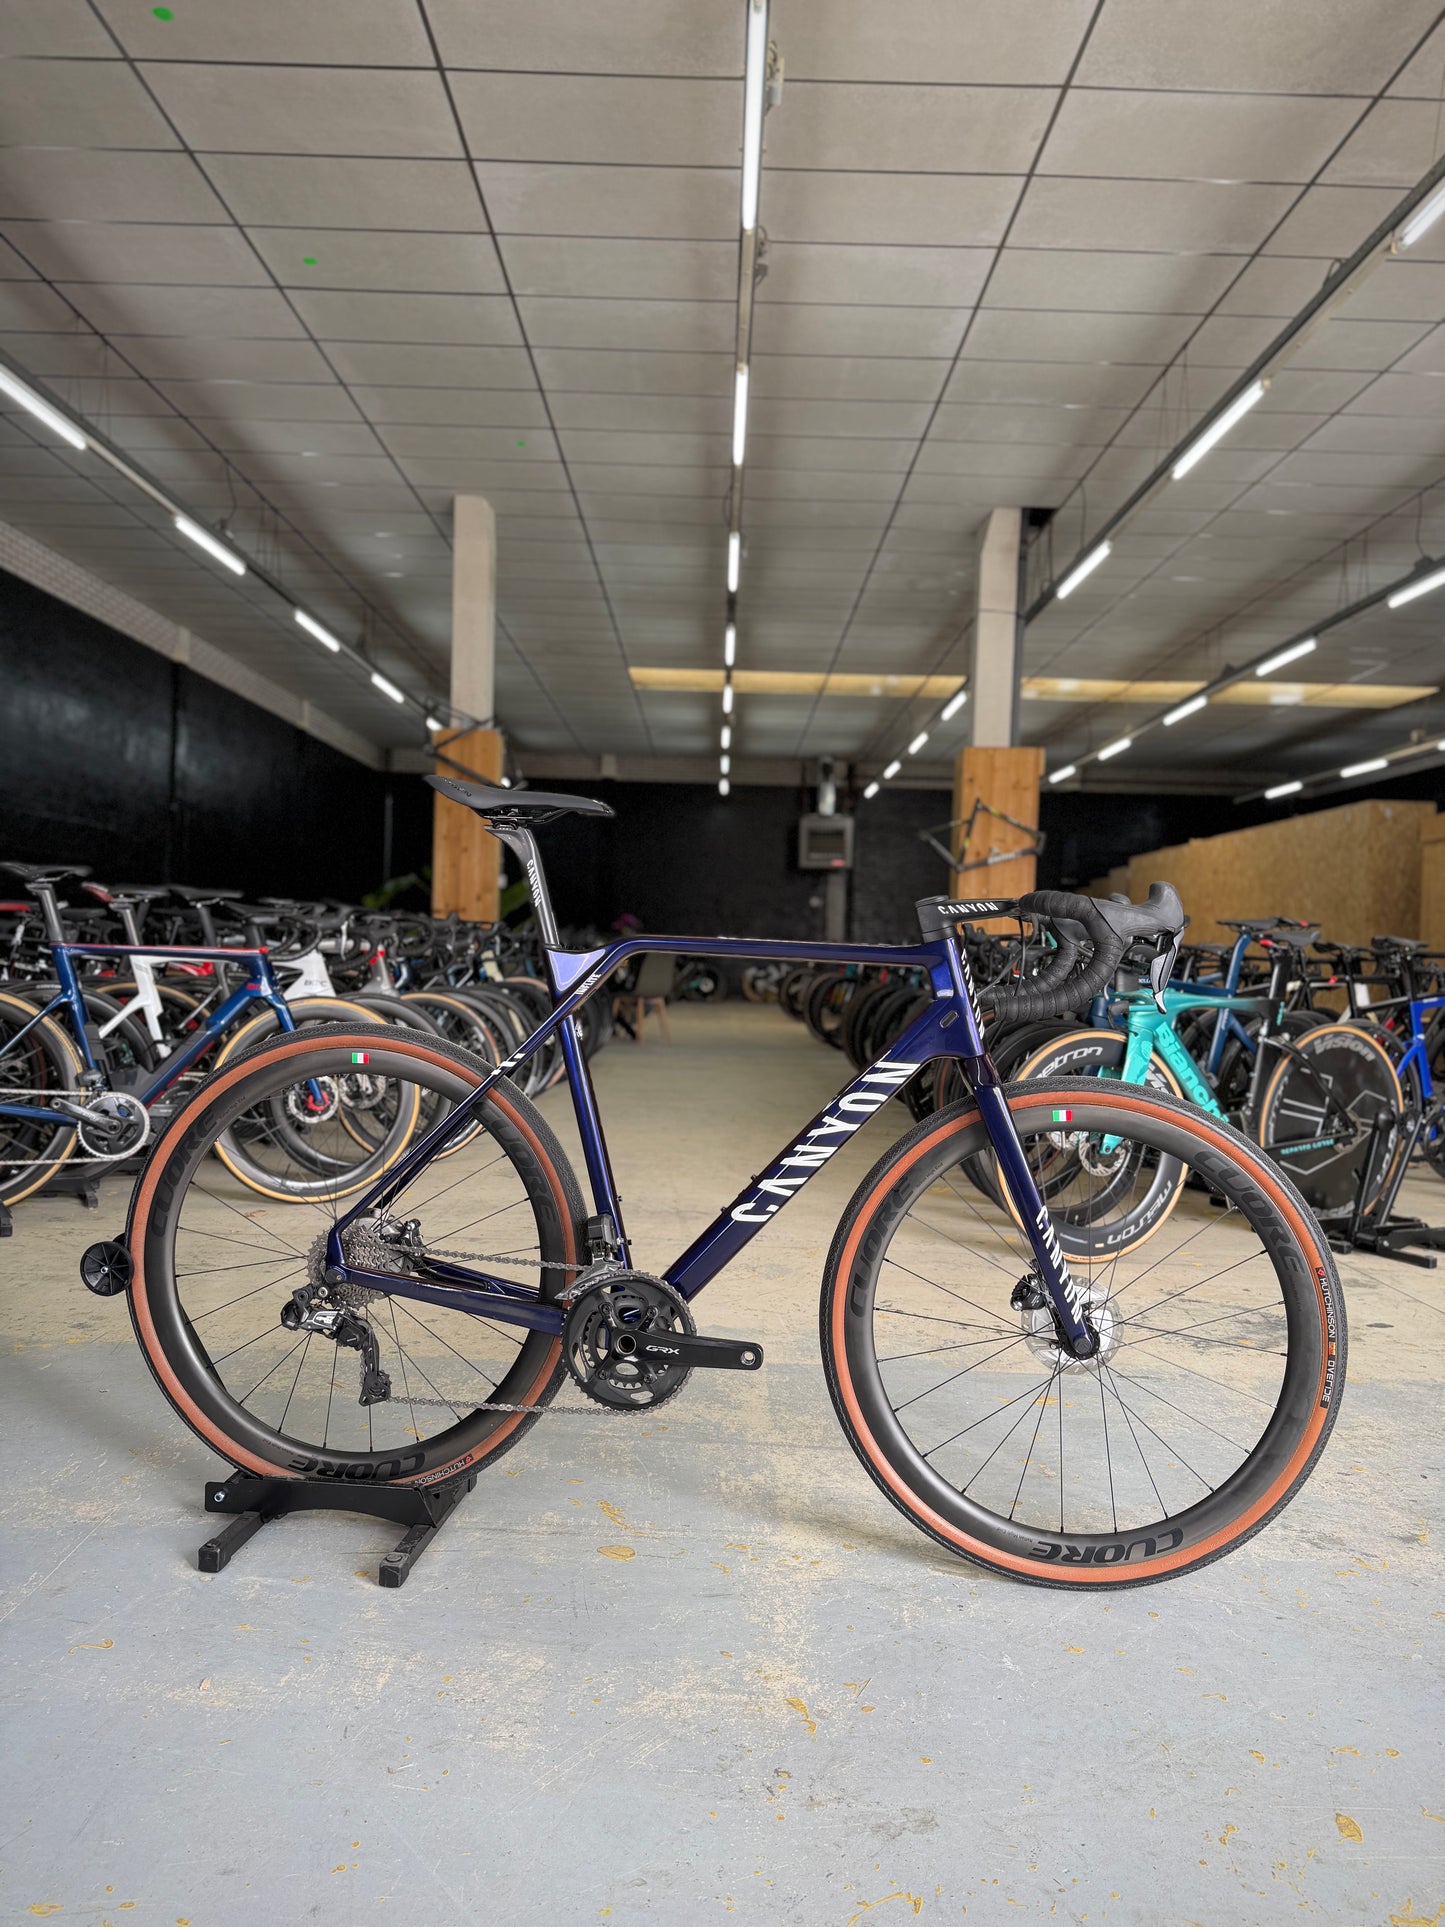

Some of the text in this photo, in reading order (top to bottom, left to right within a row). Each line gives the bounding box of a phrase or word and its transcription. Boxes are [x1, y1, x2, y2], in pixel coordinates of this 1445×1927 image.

[526, 859, 542, 907] CANYON
[937, 901, 999, 915] CANYON
[1036, 1046, 1104, 1079] etron
[1314, 1034, 1376, 1062] Vision
[731, 1061, 921, 1222] CANYON
[152, 1108, 218, 1237] CUORE
[1194, 1150, 1305, 1275] CUORE
[850, 1175, 914, 1318] CUORE
[1036, 1205, 1083, 1324] CANYON
[1320, 1278, 1336, 1338] HUTCHINSON
[645, 1345, 680, 1355] GRX
[288, 1453, 426, 1480] CUORE
[415, 1459, 466, 1487] HUTCHINSON
[1029, 1528, 1183, 1563] CUORE
